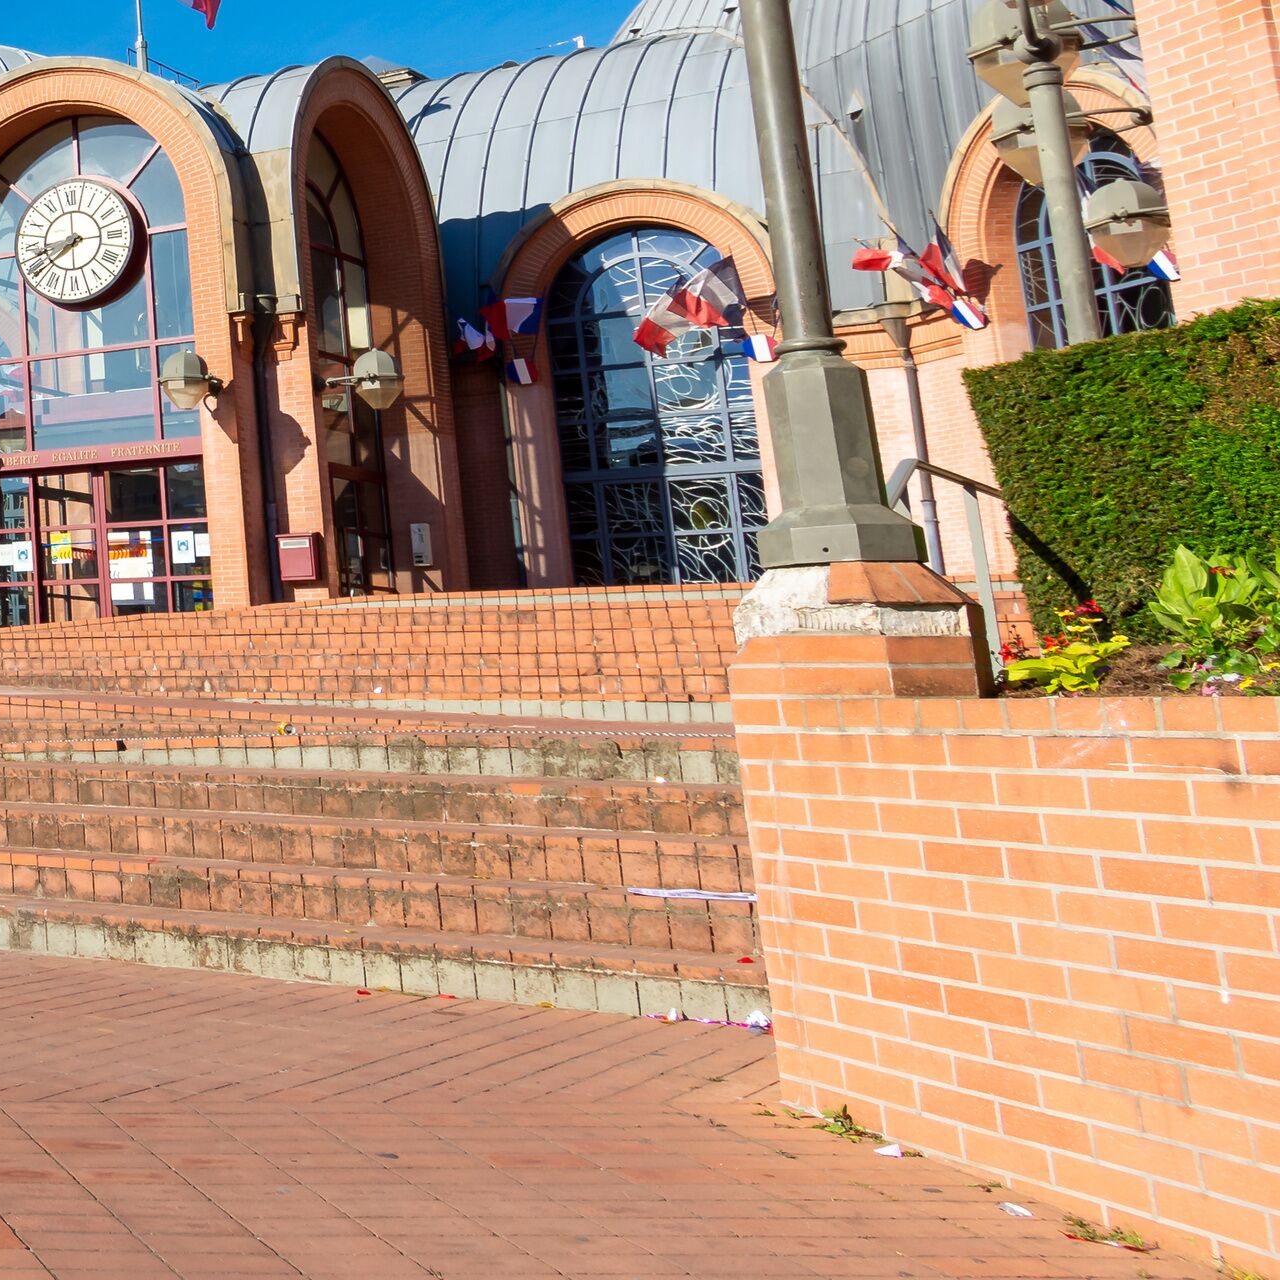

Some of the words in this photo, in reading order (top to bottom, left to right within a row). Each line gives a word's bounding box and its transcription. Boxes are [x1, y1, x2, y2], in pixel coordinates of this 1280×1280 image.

[65, 190, 77, 206] XII
[88, 193, 96, 208] I
[44, 199, 58, 214] XI
[100, 207, 115, 220] II
[30, 220, 44, 231] X
[107, 229, 122, 239] III
[46, 272, 60, 289] VII
[91, 268, 101, 282] V
[70, 276, 79, 291] VI
